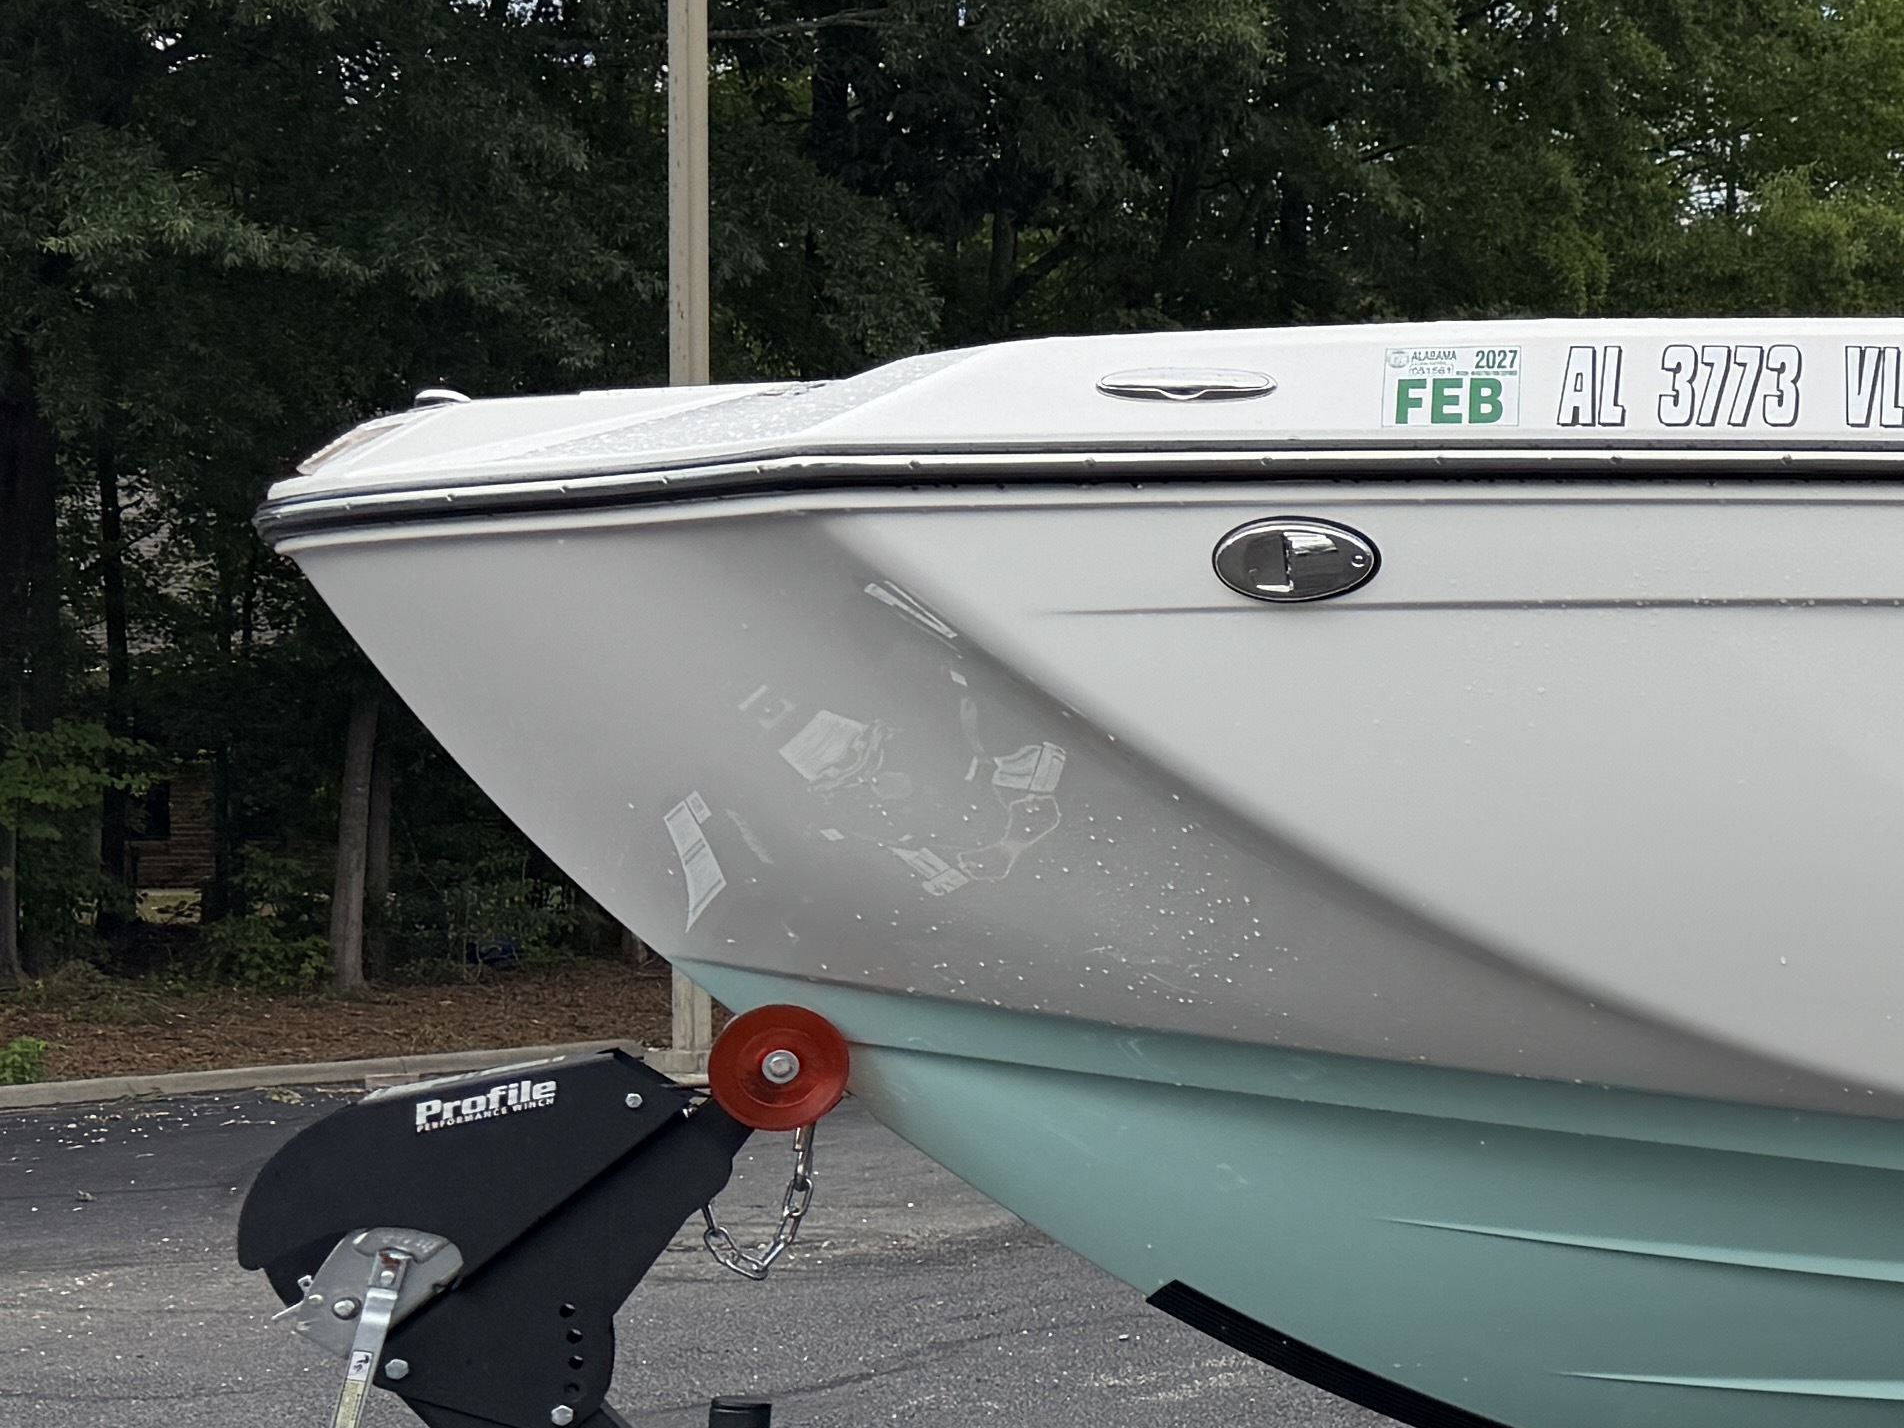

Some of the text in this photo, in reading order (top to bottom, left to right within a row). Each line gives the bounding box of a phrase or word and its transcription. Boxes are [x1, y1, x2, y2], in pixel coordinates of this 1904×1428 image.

[1475, 349, 1518, 369] 2027
[1395, 378, 1503, 424] FEB
[1557, 346, 1626, 427] AL
[1658, 345, 1802, 427] 3773
[416, 1080, 556, 1125] Profile
[416, 1098, 555, 1132] PERFORMANCE WINCH
